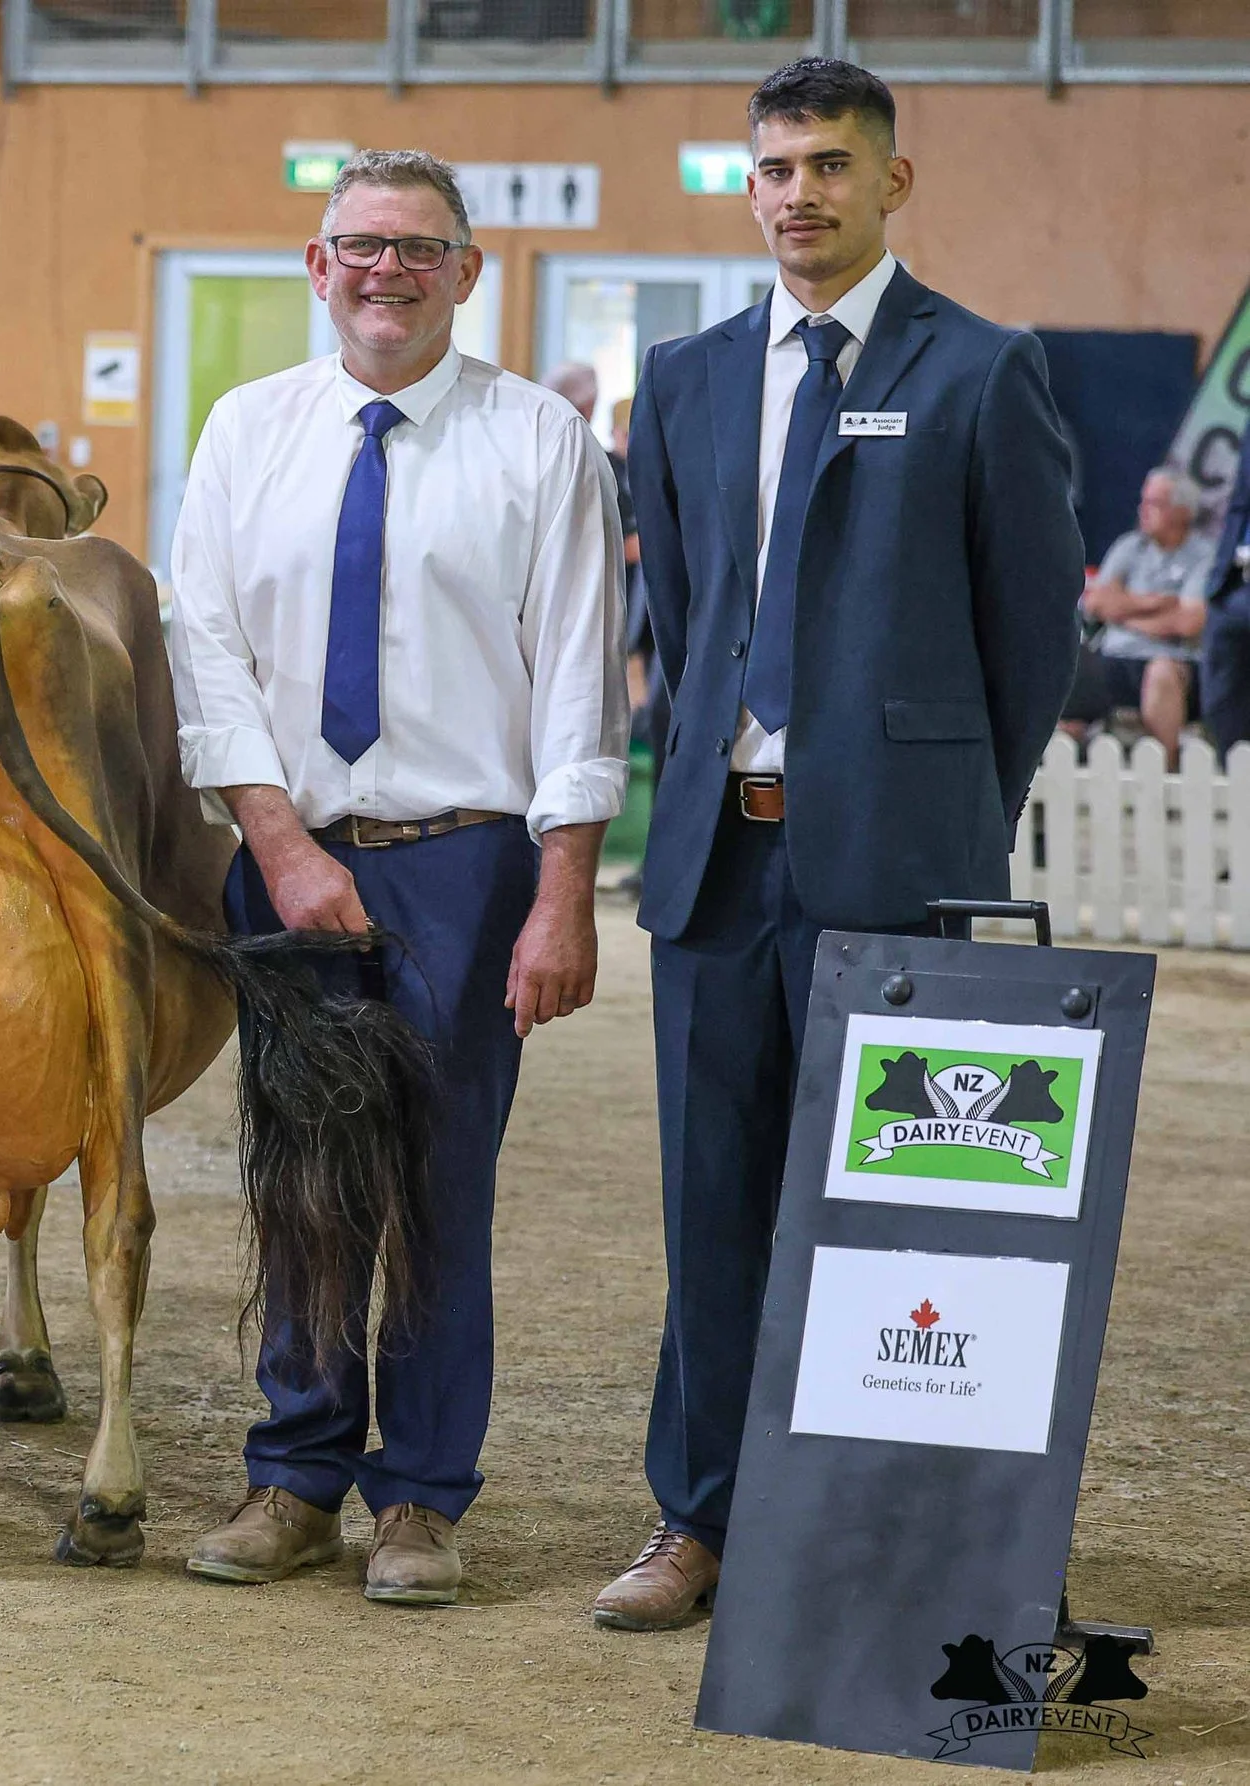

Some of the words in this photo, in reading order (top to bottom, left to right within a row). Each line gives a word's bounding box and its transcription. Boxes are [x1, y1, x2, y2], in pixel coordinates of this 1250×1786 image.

[953, 1073, 984, 1092] NZ
[862, 1374, 921, 1392] Genetics
[926, 1378, 946, 1394] for
